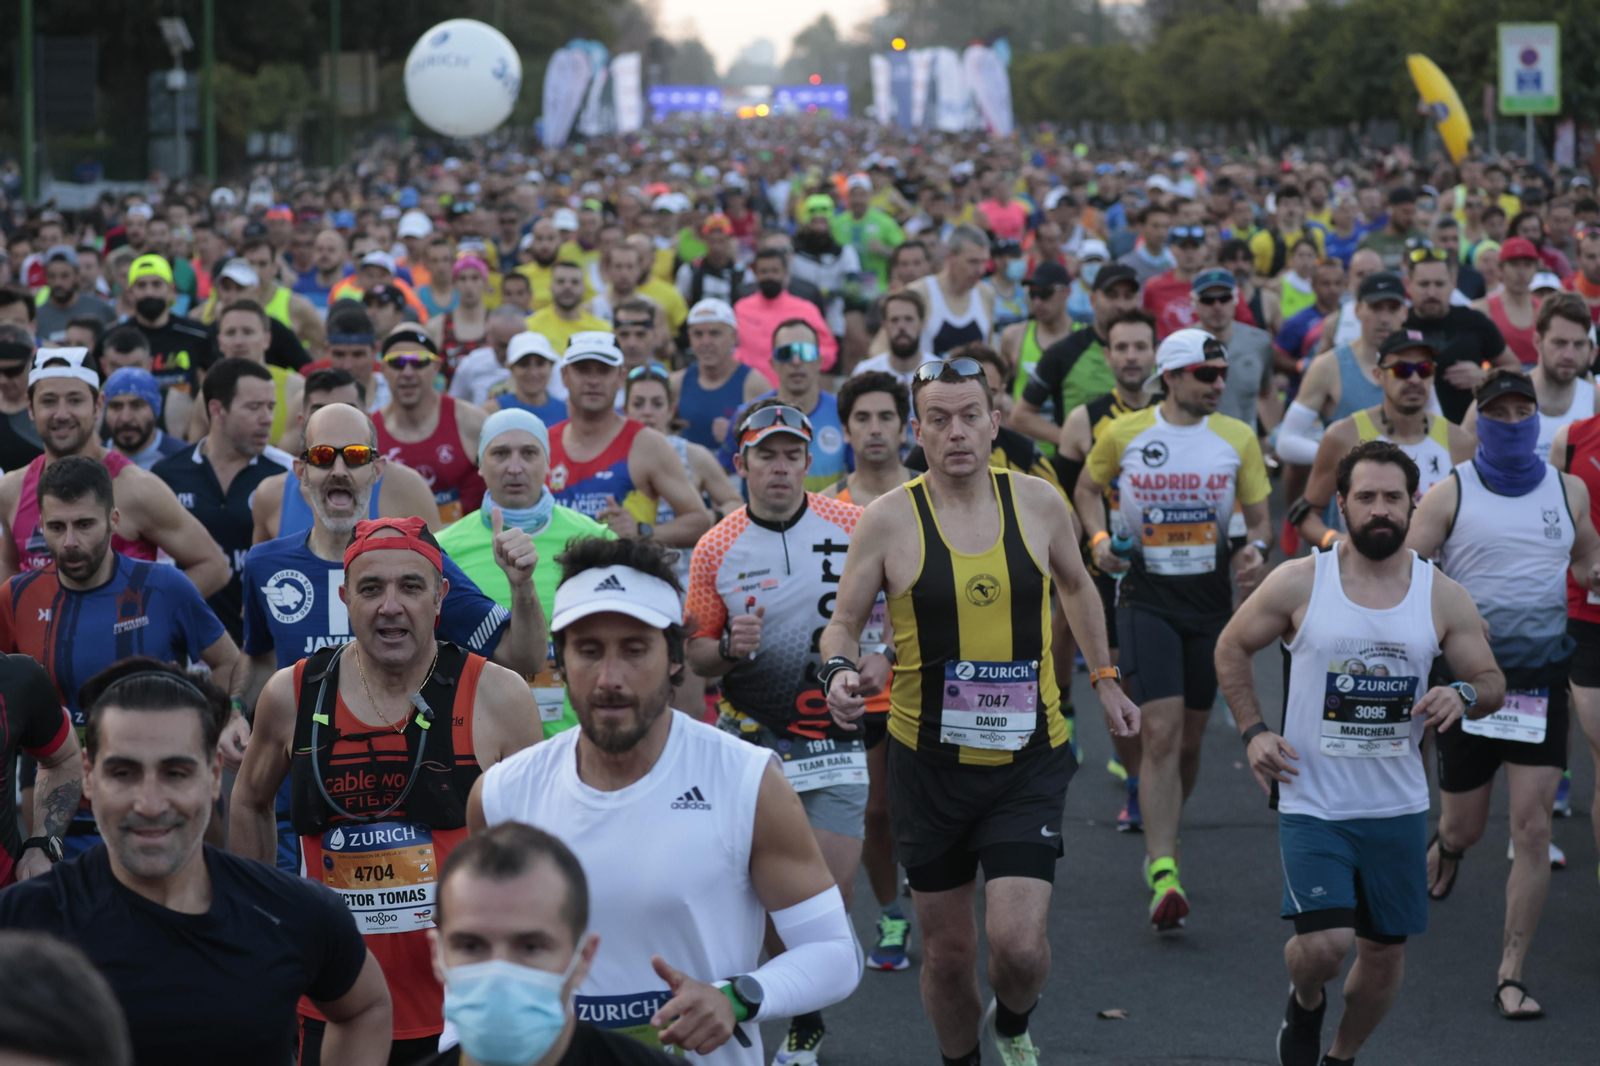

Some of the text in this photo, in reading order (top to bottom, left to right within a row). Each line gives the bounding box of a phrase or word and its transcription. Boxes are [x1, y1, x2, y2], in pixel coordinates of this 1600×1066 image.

[1165, 510, 1208, 521] ZURICH
[273, 570, 299, 582] TIGERS
[299, 579, 313, 616] RUNNING
[276, 613, 295, 622] CLUB
[978, 666, 1029, 679] ZURICH
[1357, 679, 1408, 692] ZURICH
[977, 694, 1010, 707] 7047
[1355, 705, 1387, 719] 3095
[975, 715, 1007, 727] DAVID
[1340, 725, 1396, 737] MARCHENA
[806, 739, 836, 753] 1911
[798, 754, 853, 772] TEAM RAÑA
[325, 769, 377, 794] cable
[670, 800, 712, 811] adidas
[349, 824, 417, 847] ZURICH
[354, 863, 395, 882] 4704
[336, 888, 427, 906] CTOR TOMAS
[578, 998, 659, 1022] ZURICH
